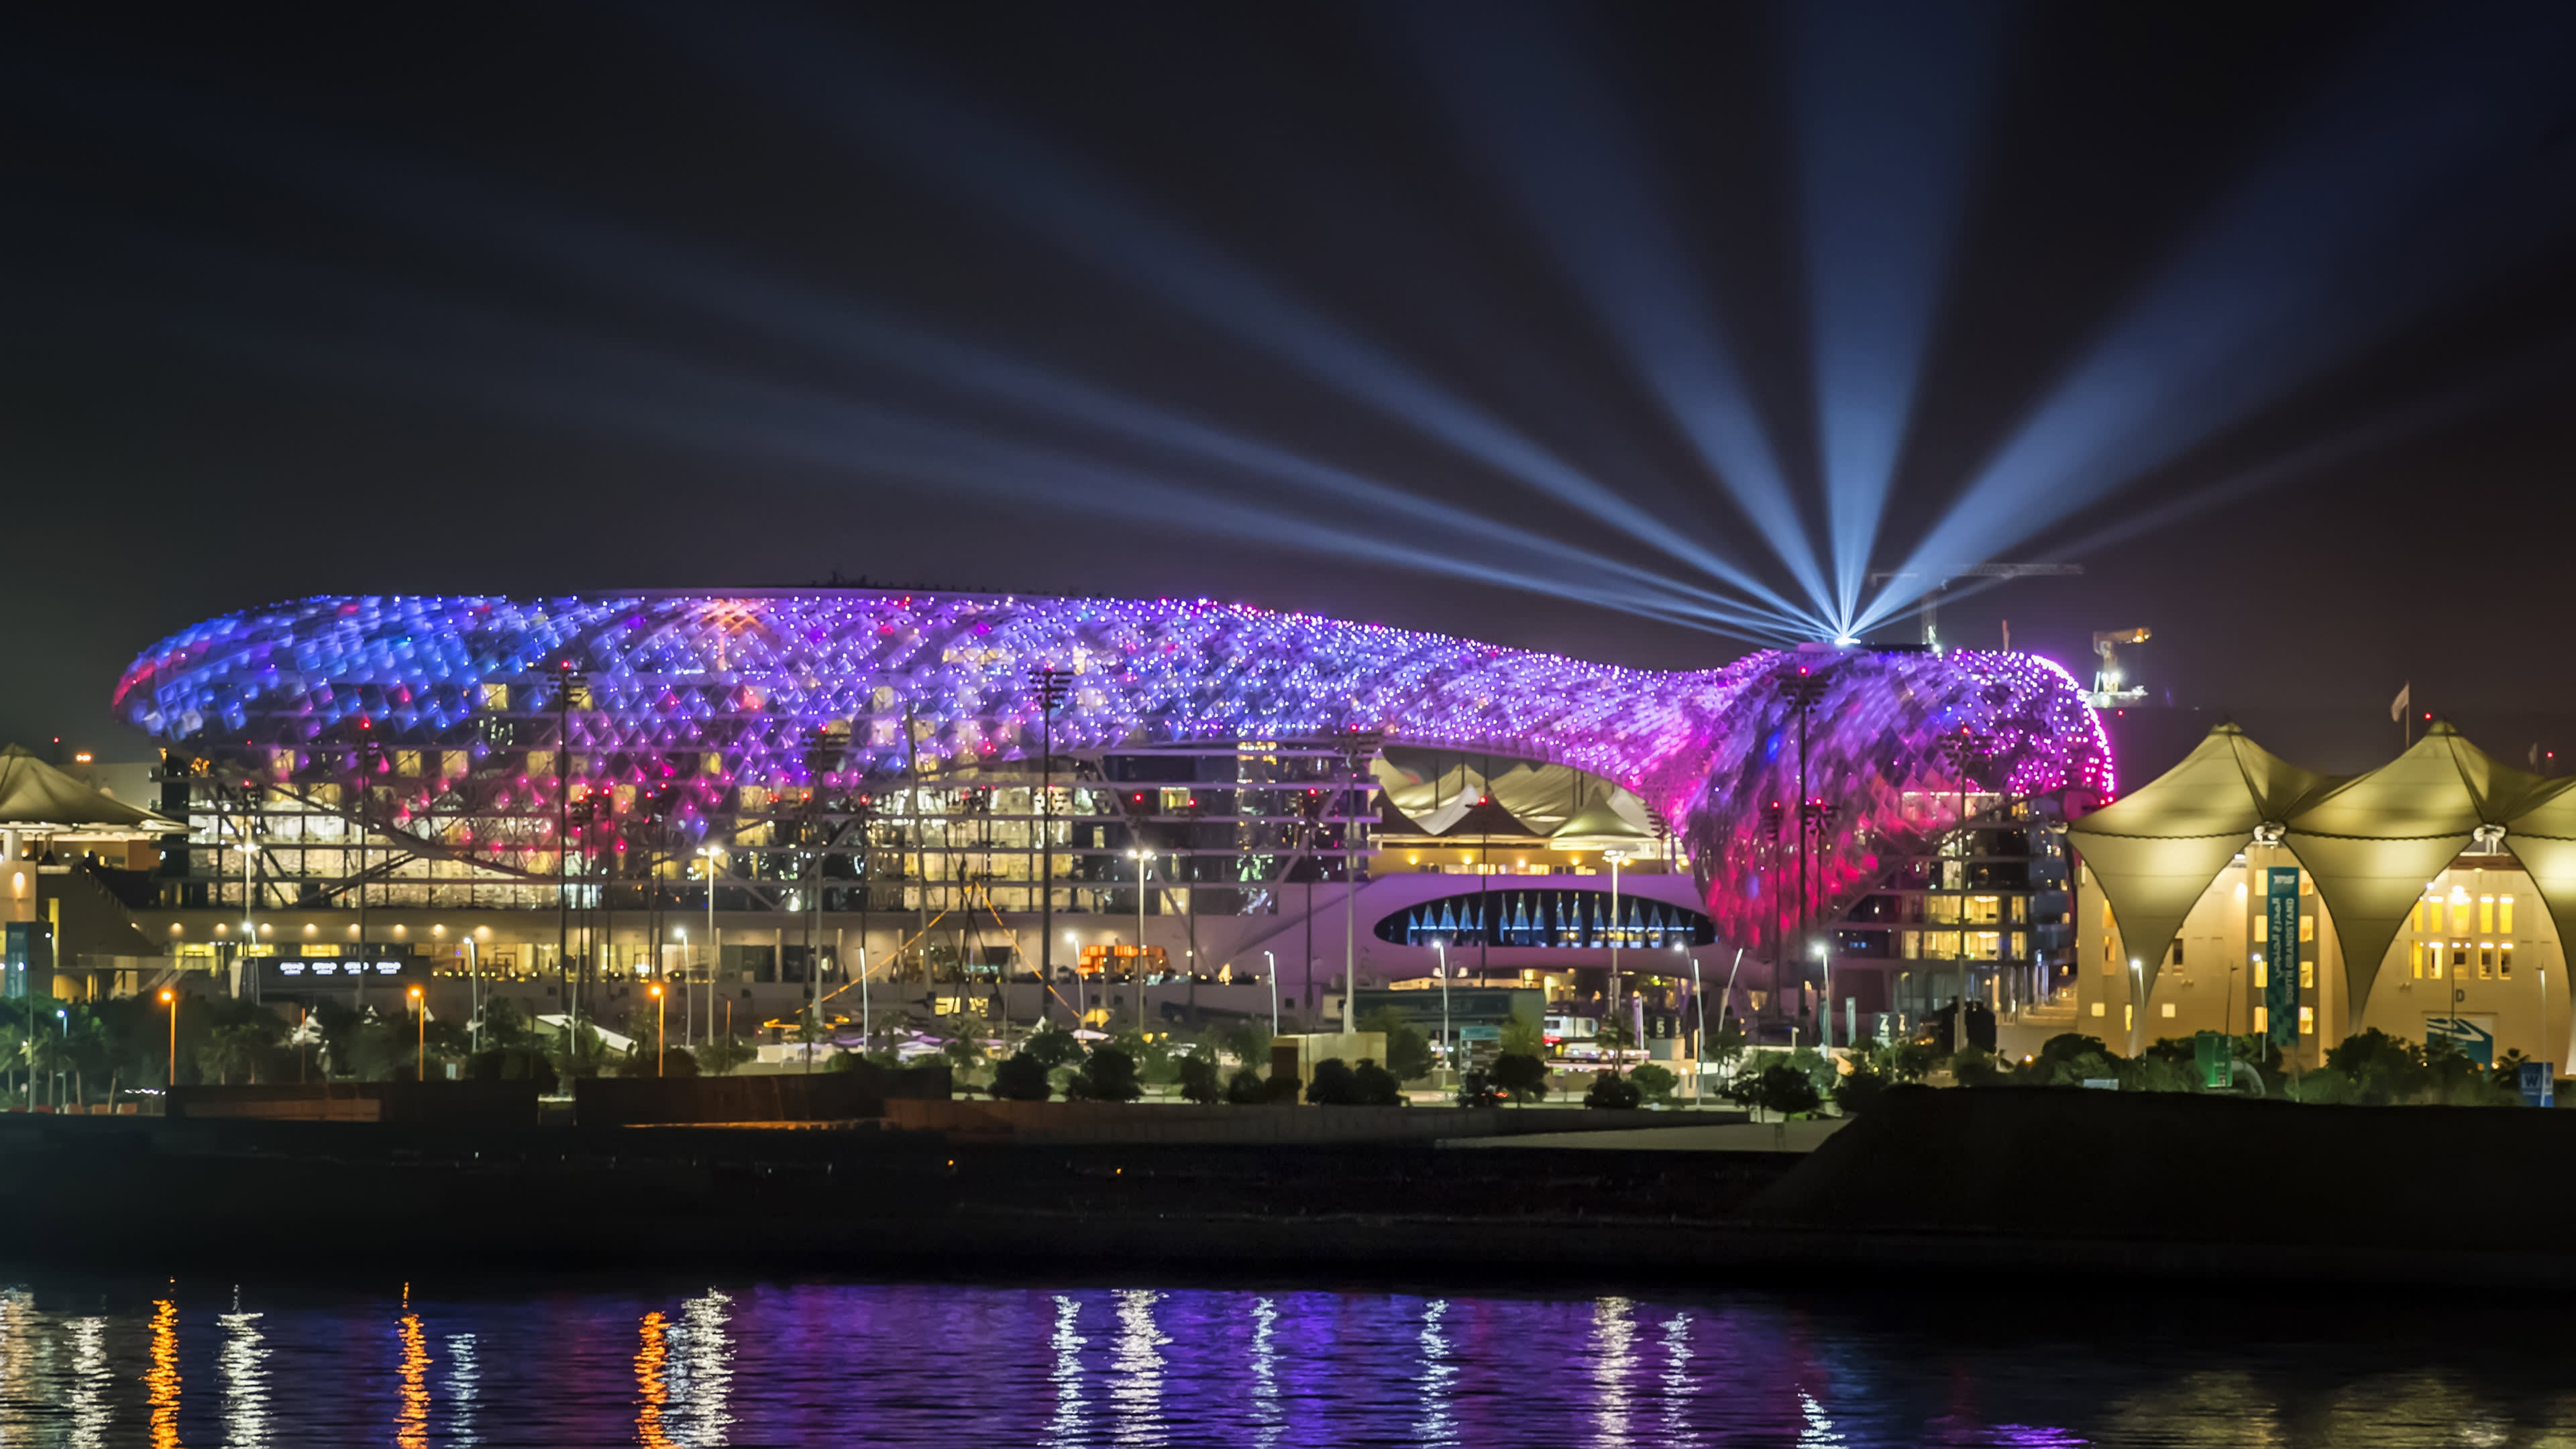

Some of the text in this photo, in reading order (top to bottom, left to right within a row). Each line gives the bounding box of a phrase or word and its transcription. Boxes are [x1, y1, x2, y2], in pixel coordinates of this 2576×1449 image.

[2286, 898, 2295, 1004] SOUTH GRANDSTAND
[2455, 989, 2465, 1003] D
